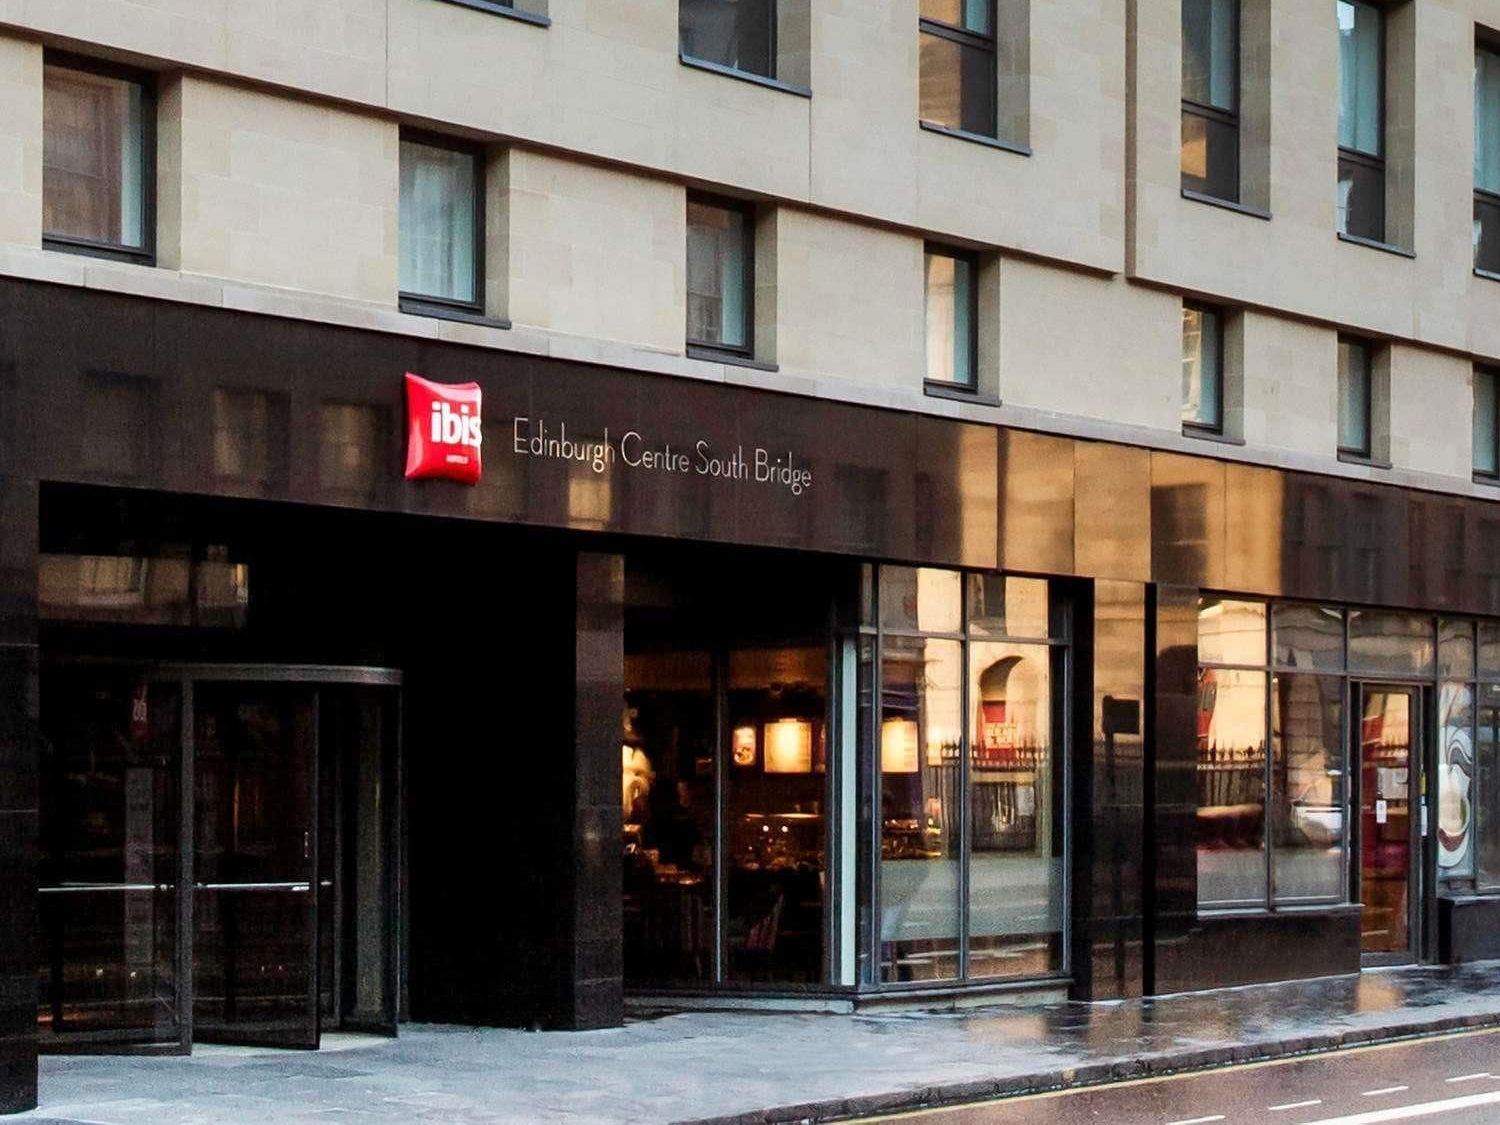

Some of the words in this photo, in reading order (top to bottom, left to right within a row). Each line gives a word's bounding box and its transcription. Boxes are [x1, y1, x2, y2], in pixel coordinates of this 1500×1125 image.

[431, 401, 482, 447] ibis
[514, 417, 616, 473] Edinburgh
[621, 431, 690, 473] Centre
[696, 440, 749, 480] South
[755, 448, 812, 495] Bridge
